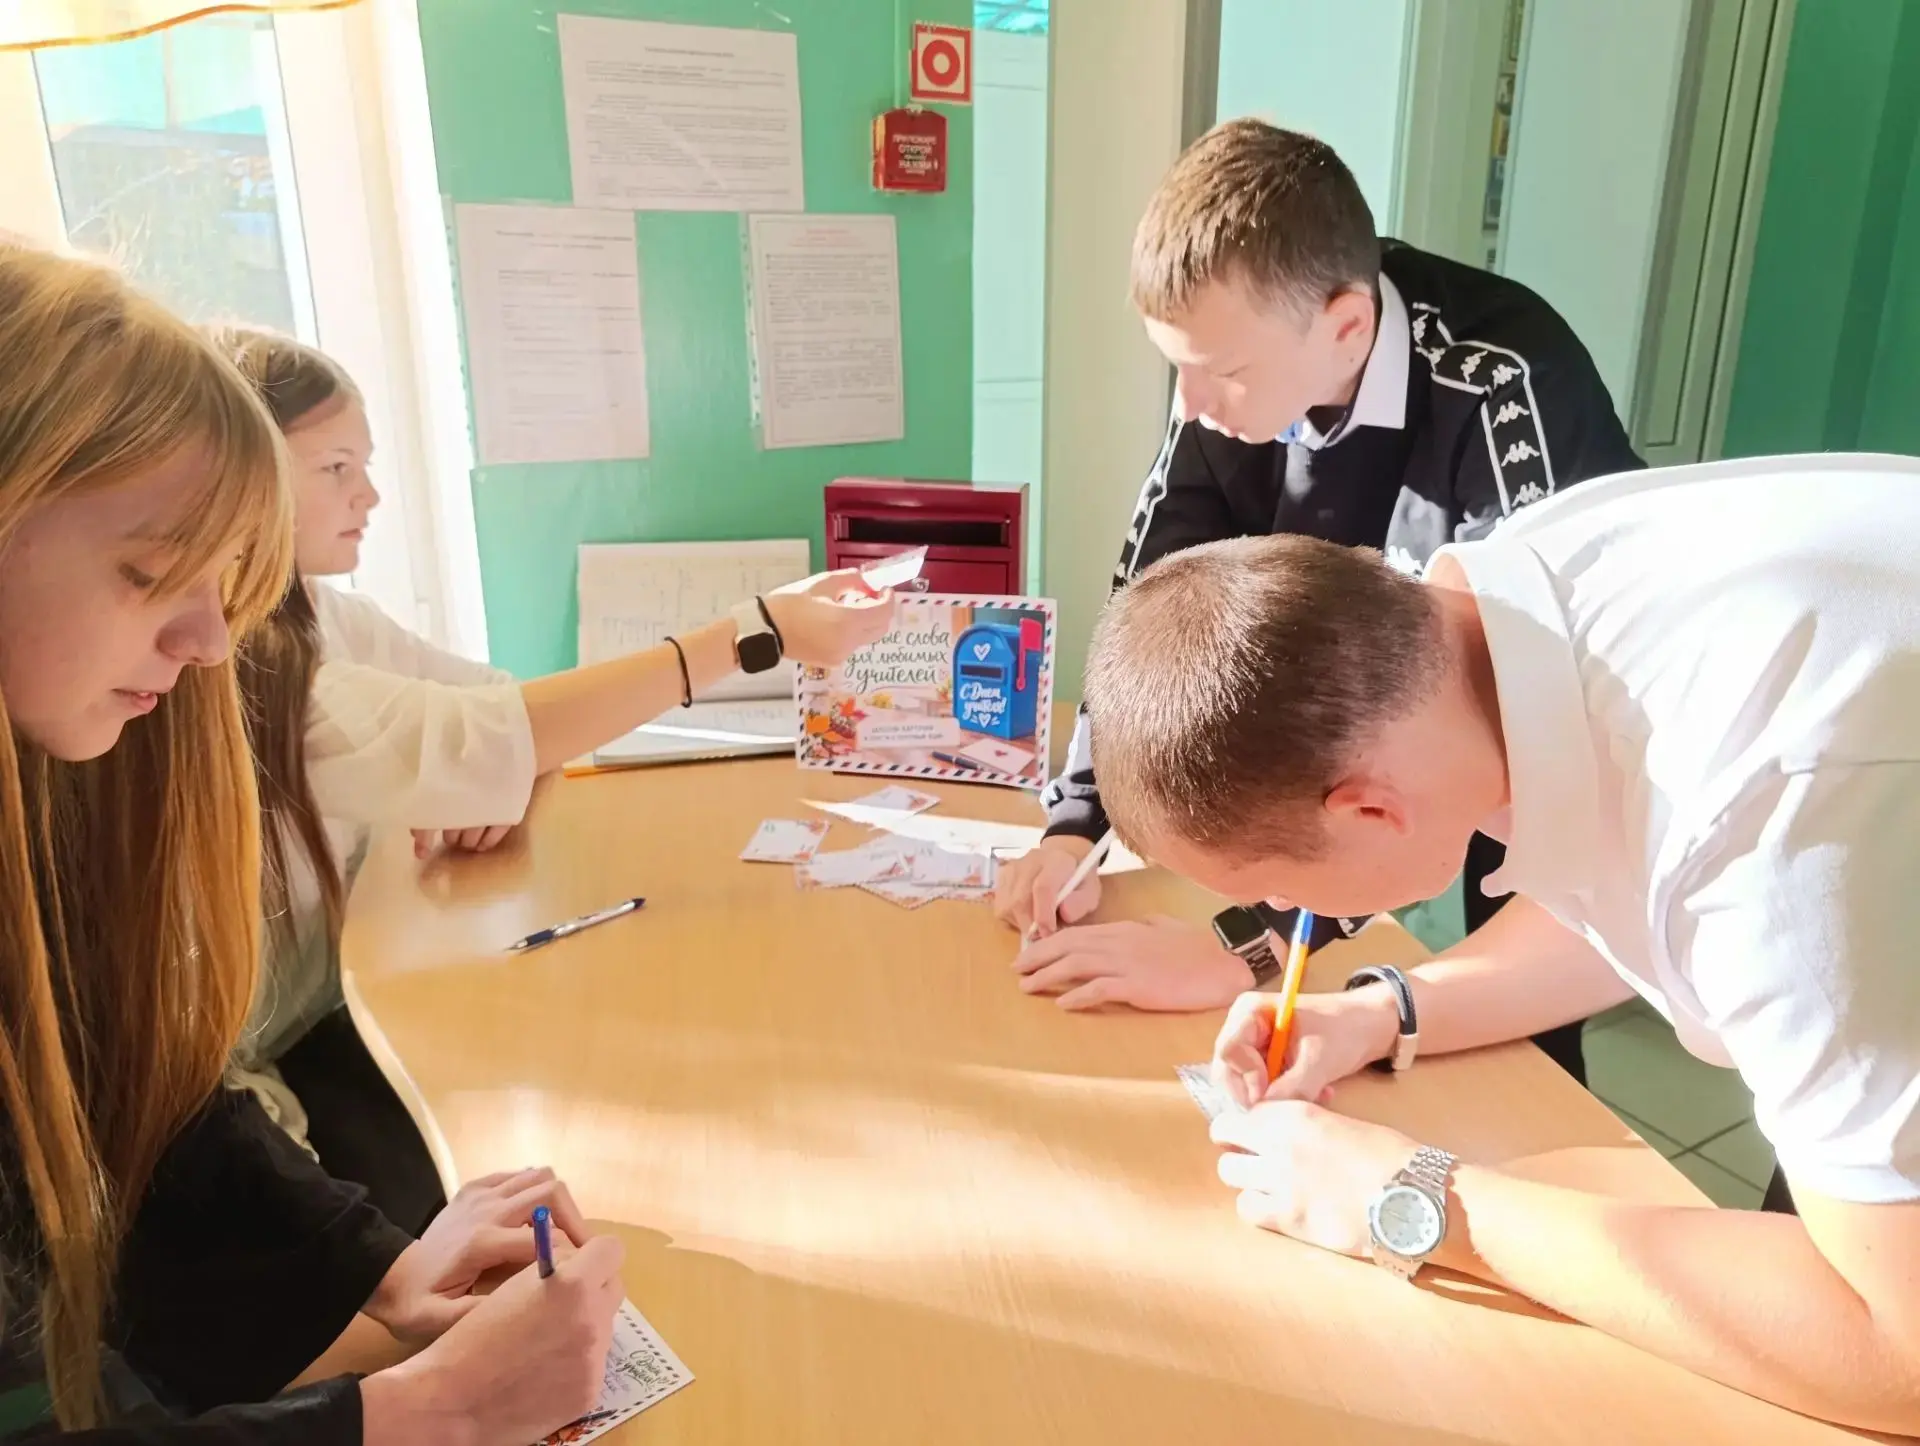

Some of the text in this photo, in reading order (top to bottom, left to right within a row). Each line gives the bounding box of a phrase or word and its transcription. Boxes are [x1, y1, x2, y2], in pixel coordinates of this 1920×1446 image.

[906, 622, 951, 648] слова
[845, 646, 949, 679] для любимых
[856, 665, 937, 696] учителей
